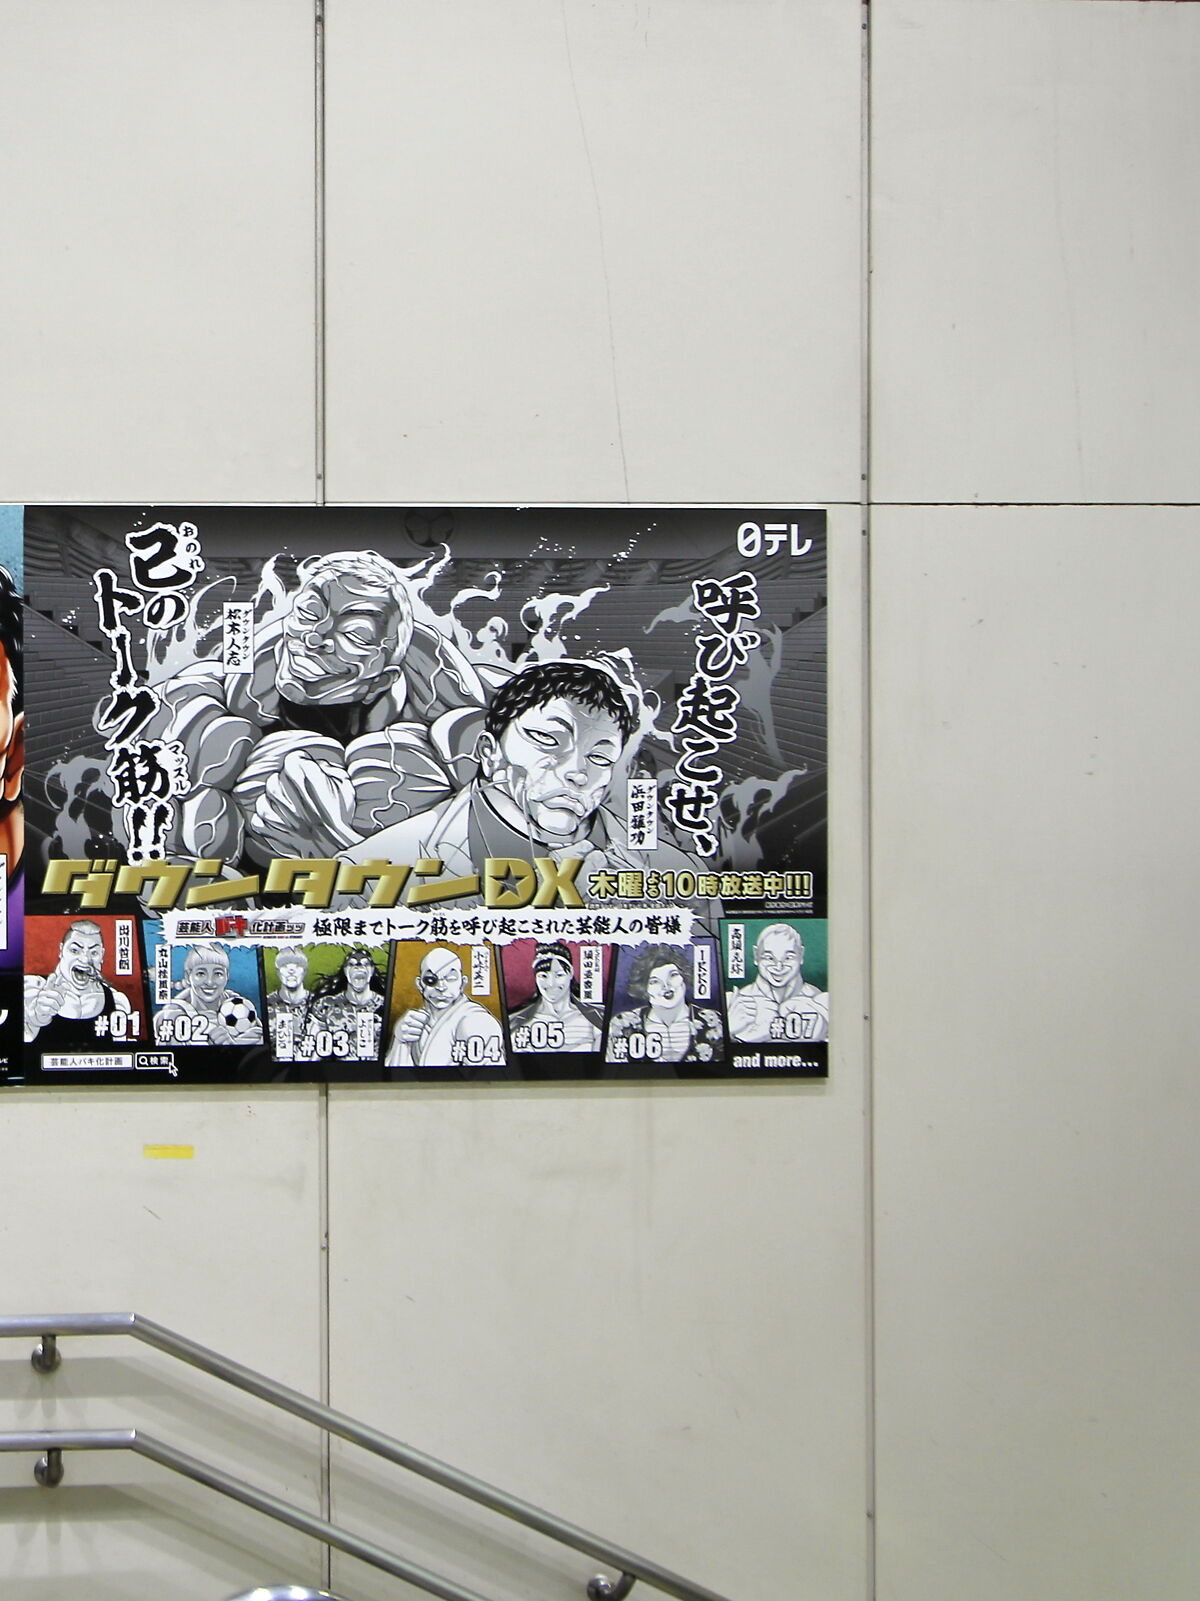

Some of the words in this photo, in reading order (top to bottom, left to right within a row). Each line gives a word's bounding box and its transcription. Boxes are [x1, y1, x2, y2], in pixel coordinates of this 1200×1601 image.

[126, 523, 195, 629] 己の
[94, 1011, 141, 1037] #01
[159, 1015, 209, 1042] #02
[515, 1021, 565, 1049] #05
[770, 1011, 819, 1039] #07
[301, 1030, 350, 1057] #03
[451, 1035, 501, 1063] #04
[613, 1033, 663, 1059] #06
[733, 1053, 760, 1068] and
